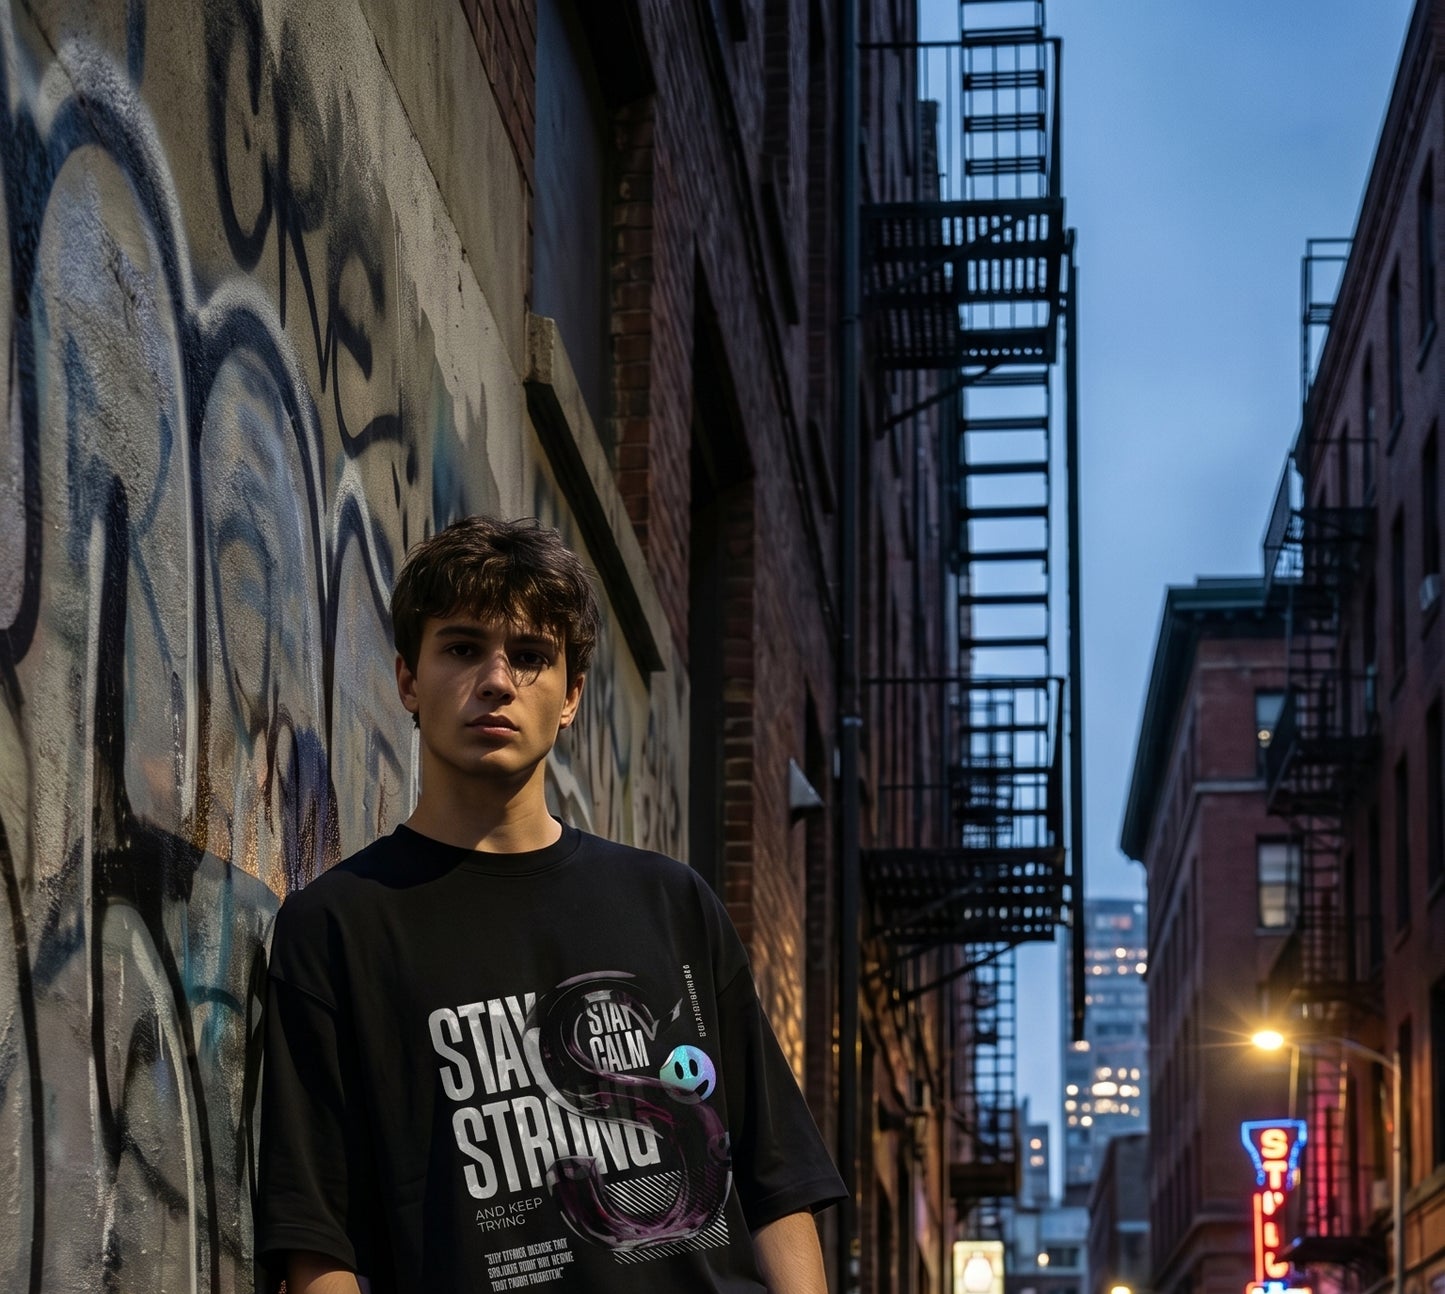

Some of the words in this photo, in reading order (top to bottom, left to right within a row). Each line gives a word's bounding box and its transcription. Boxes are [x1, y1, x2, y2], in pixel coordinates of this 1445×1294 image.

[589, 1028, 651, 1073] CALM
[452, 1094, 662, 1200] STRONG
[475, 1205, 506, 1221] AND
[508, 1197, 543, 1214] KEEP
[477, 1213, 527, 1233] TRYING
